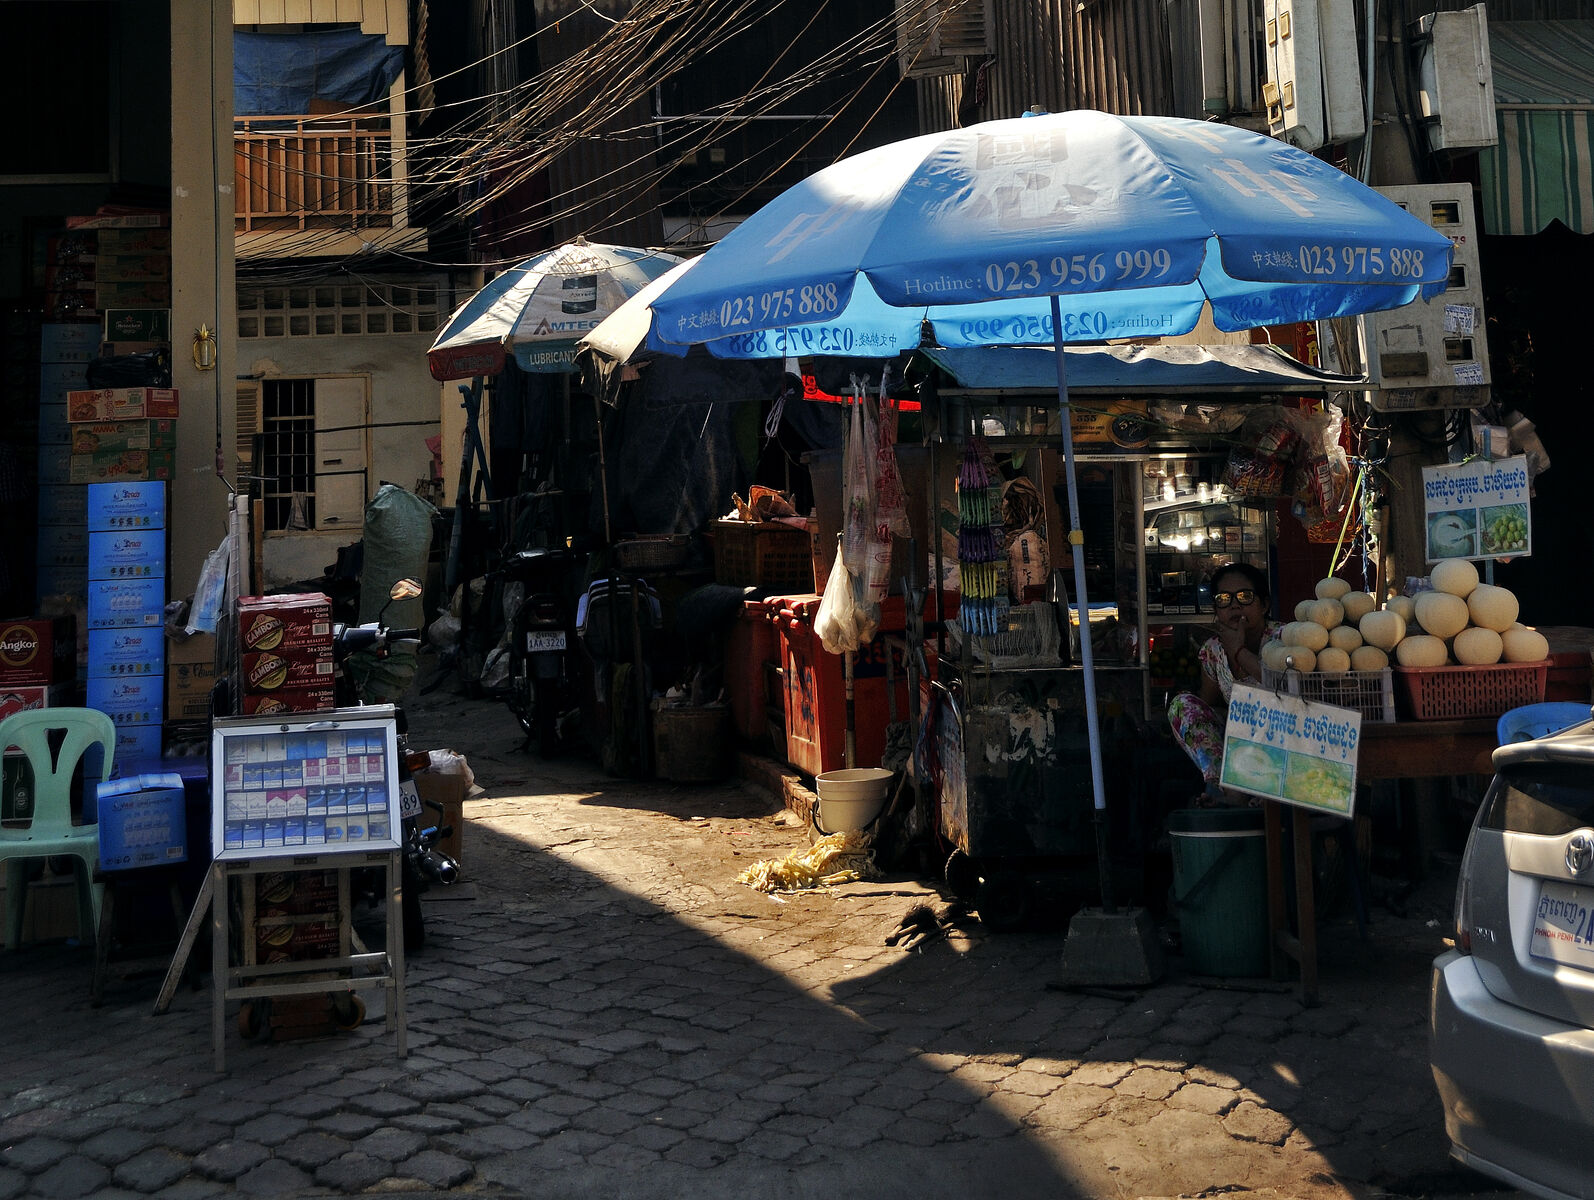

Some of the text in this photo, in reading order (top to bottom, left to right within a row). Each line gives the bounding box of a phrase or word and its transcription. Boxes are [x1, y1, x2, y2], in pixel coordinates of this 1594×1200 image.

[986, 260, 1041, 292] 023
[1050, 254, 1106, 287] 956
[1115, 249, 1171, 280] 999
[1299, 245, 1336, 275] 023
[1341, 247, 1384, 275] 975
[1390, 248, 1424, 278] 888
[720, 295, 754, 328] 023
[760, 288, 795, 322] 975
[799, 282, 838, 315] 888
[0, 640, 38, 652] Angkor
[400, 794, 417, 811] 89
[1534, 928, 1574, 942] PHNOM PENH
